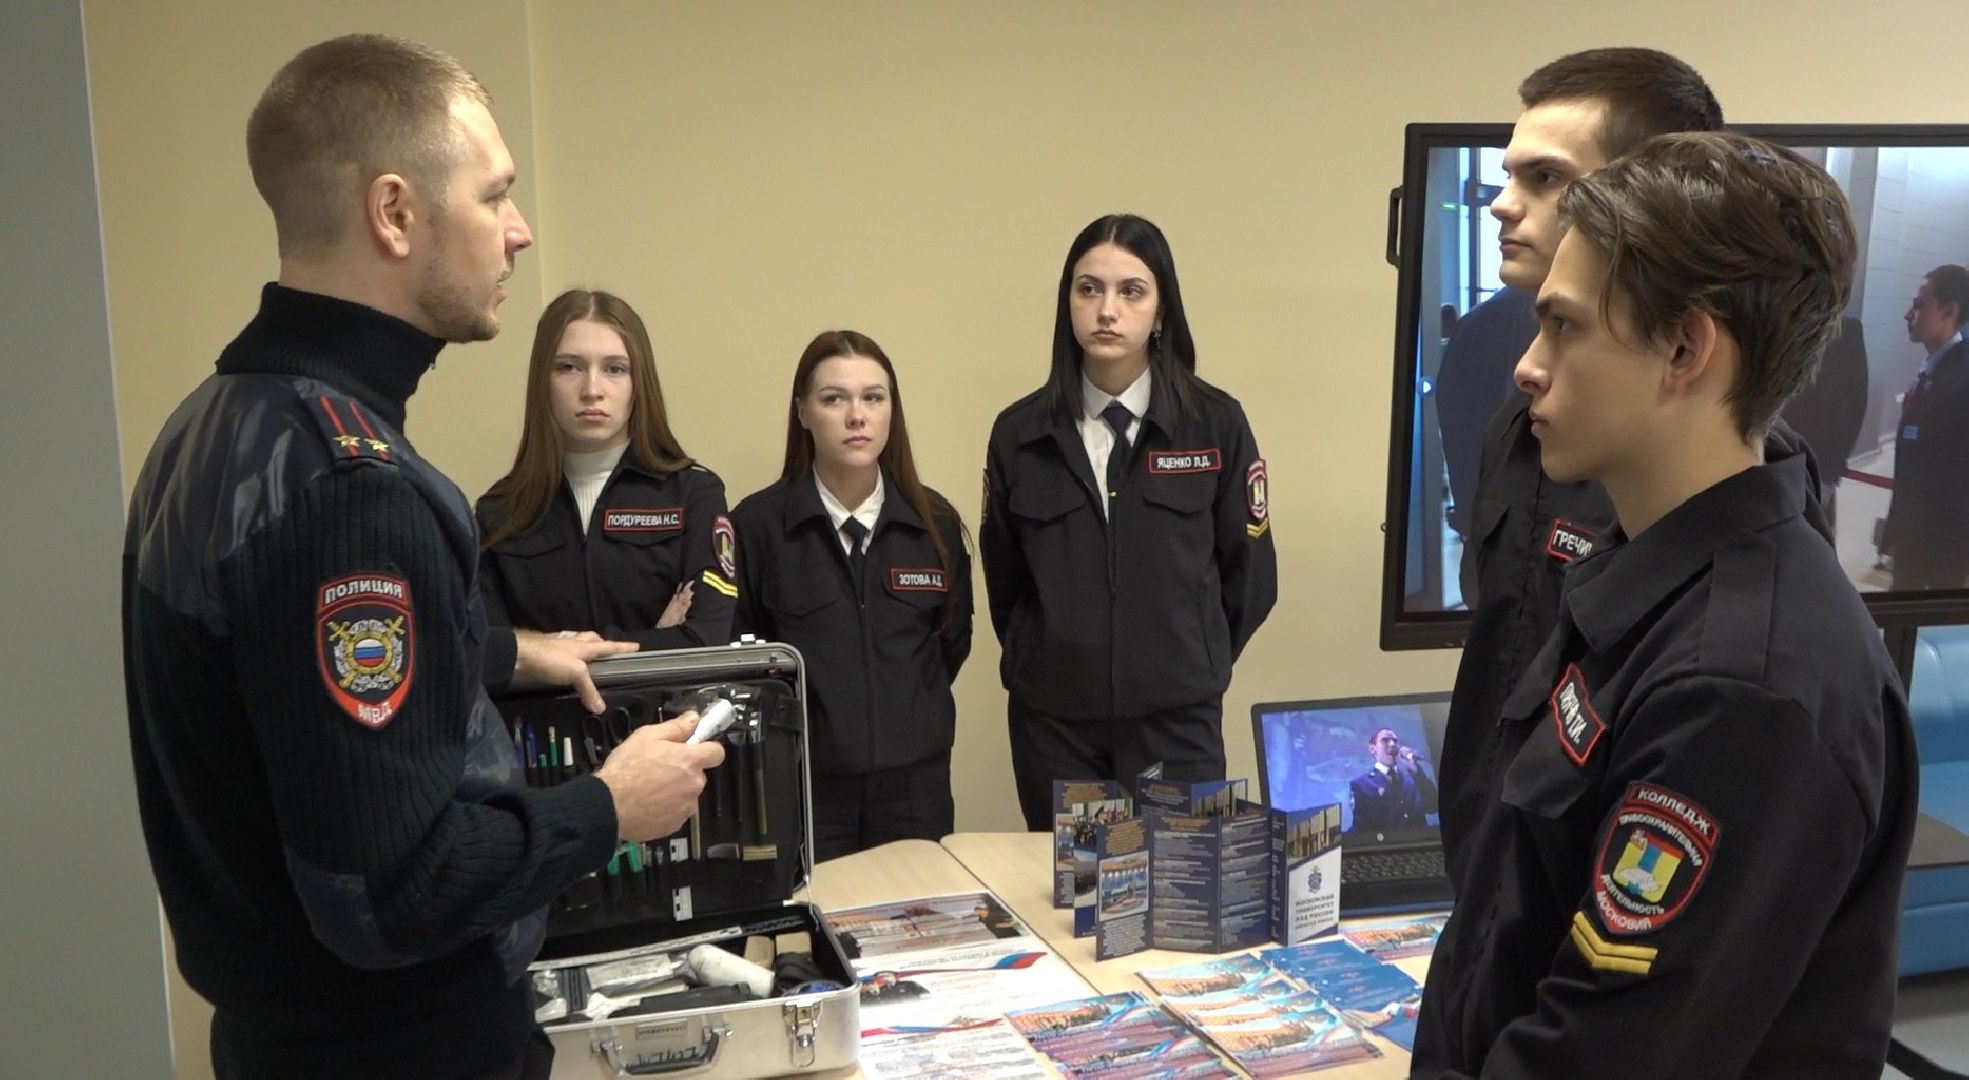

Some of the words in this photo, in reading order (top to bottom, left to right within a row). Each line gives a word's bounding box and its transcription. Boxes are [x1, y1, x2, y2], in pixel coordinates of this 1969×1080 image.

[1156, 456, 1192, 470] ЯЦЕНКО
[1552, 528, 1593, 557] ГРЕЧИ
[325, 579, 403, 604] ПОЛИЦИЯ
[899, 573, 931, 586] ЗОТОВА
[357, 701, 393, 724] МВД
[1637, 787, 1711, 836] КОЛЛЕДЖ
